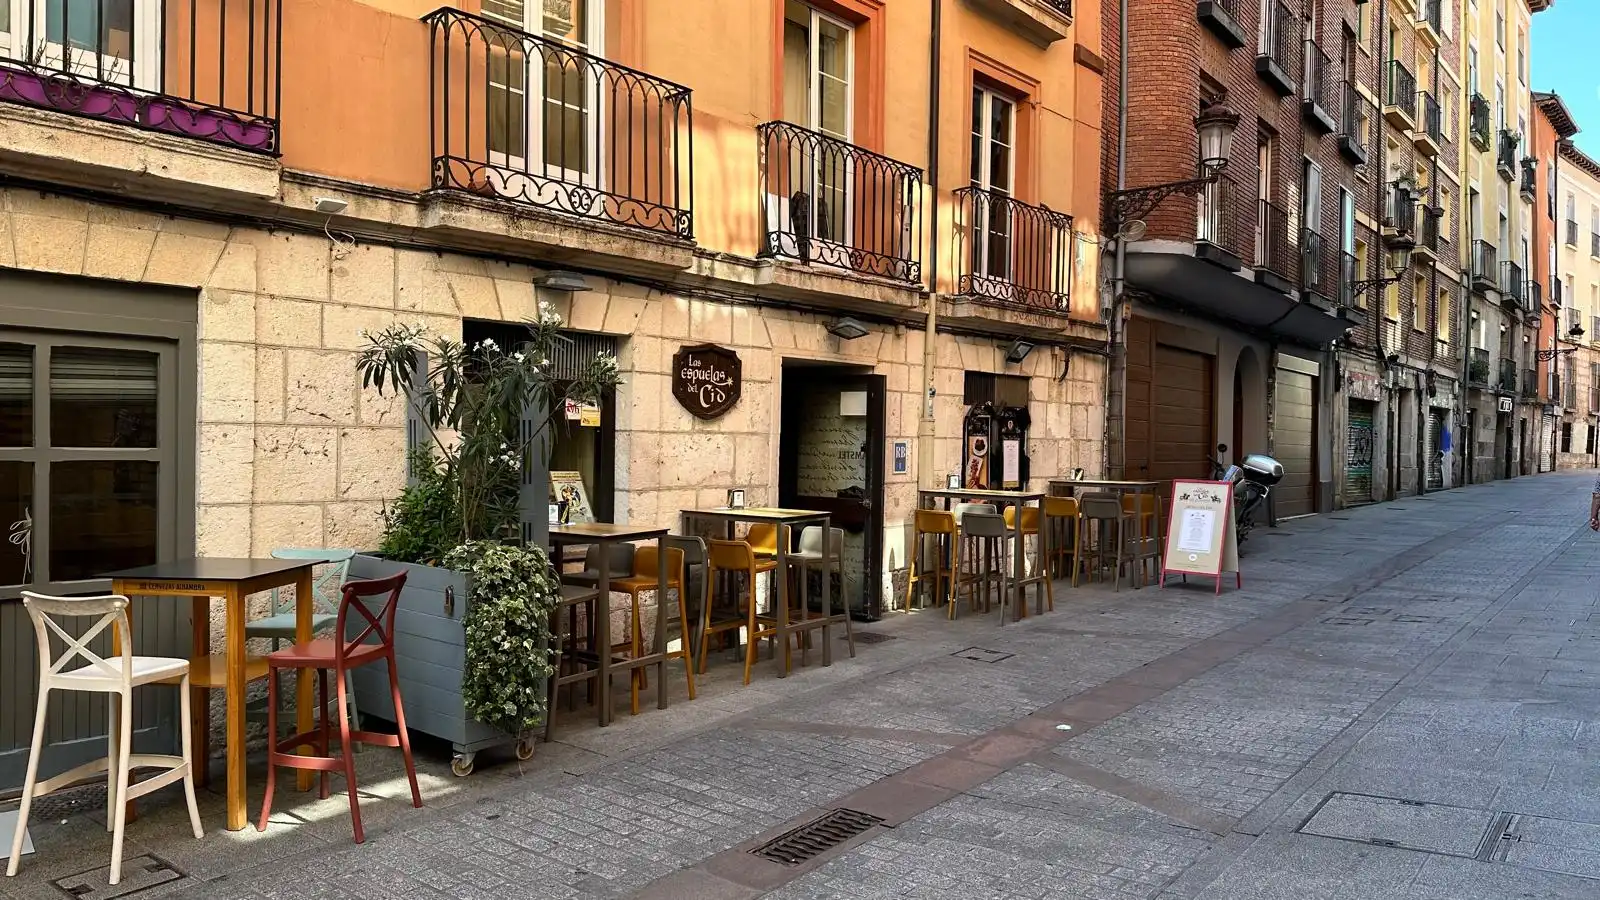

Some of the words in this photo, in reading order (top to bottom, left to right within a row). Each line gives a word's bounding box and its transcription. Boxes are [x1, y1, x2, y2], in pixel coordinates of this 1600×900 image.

[689, 354, 701, 366] Las
[681, 365, 727, 385] espuelas
[687, 383, 698, 392] del
[700, 385, 725, 407] Cid
